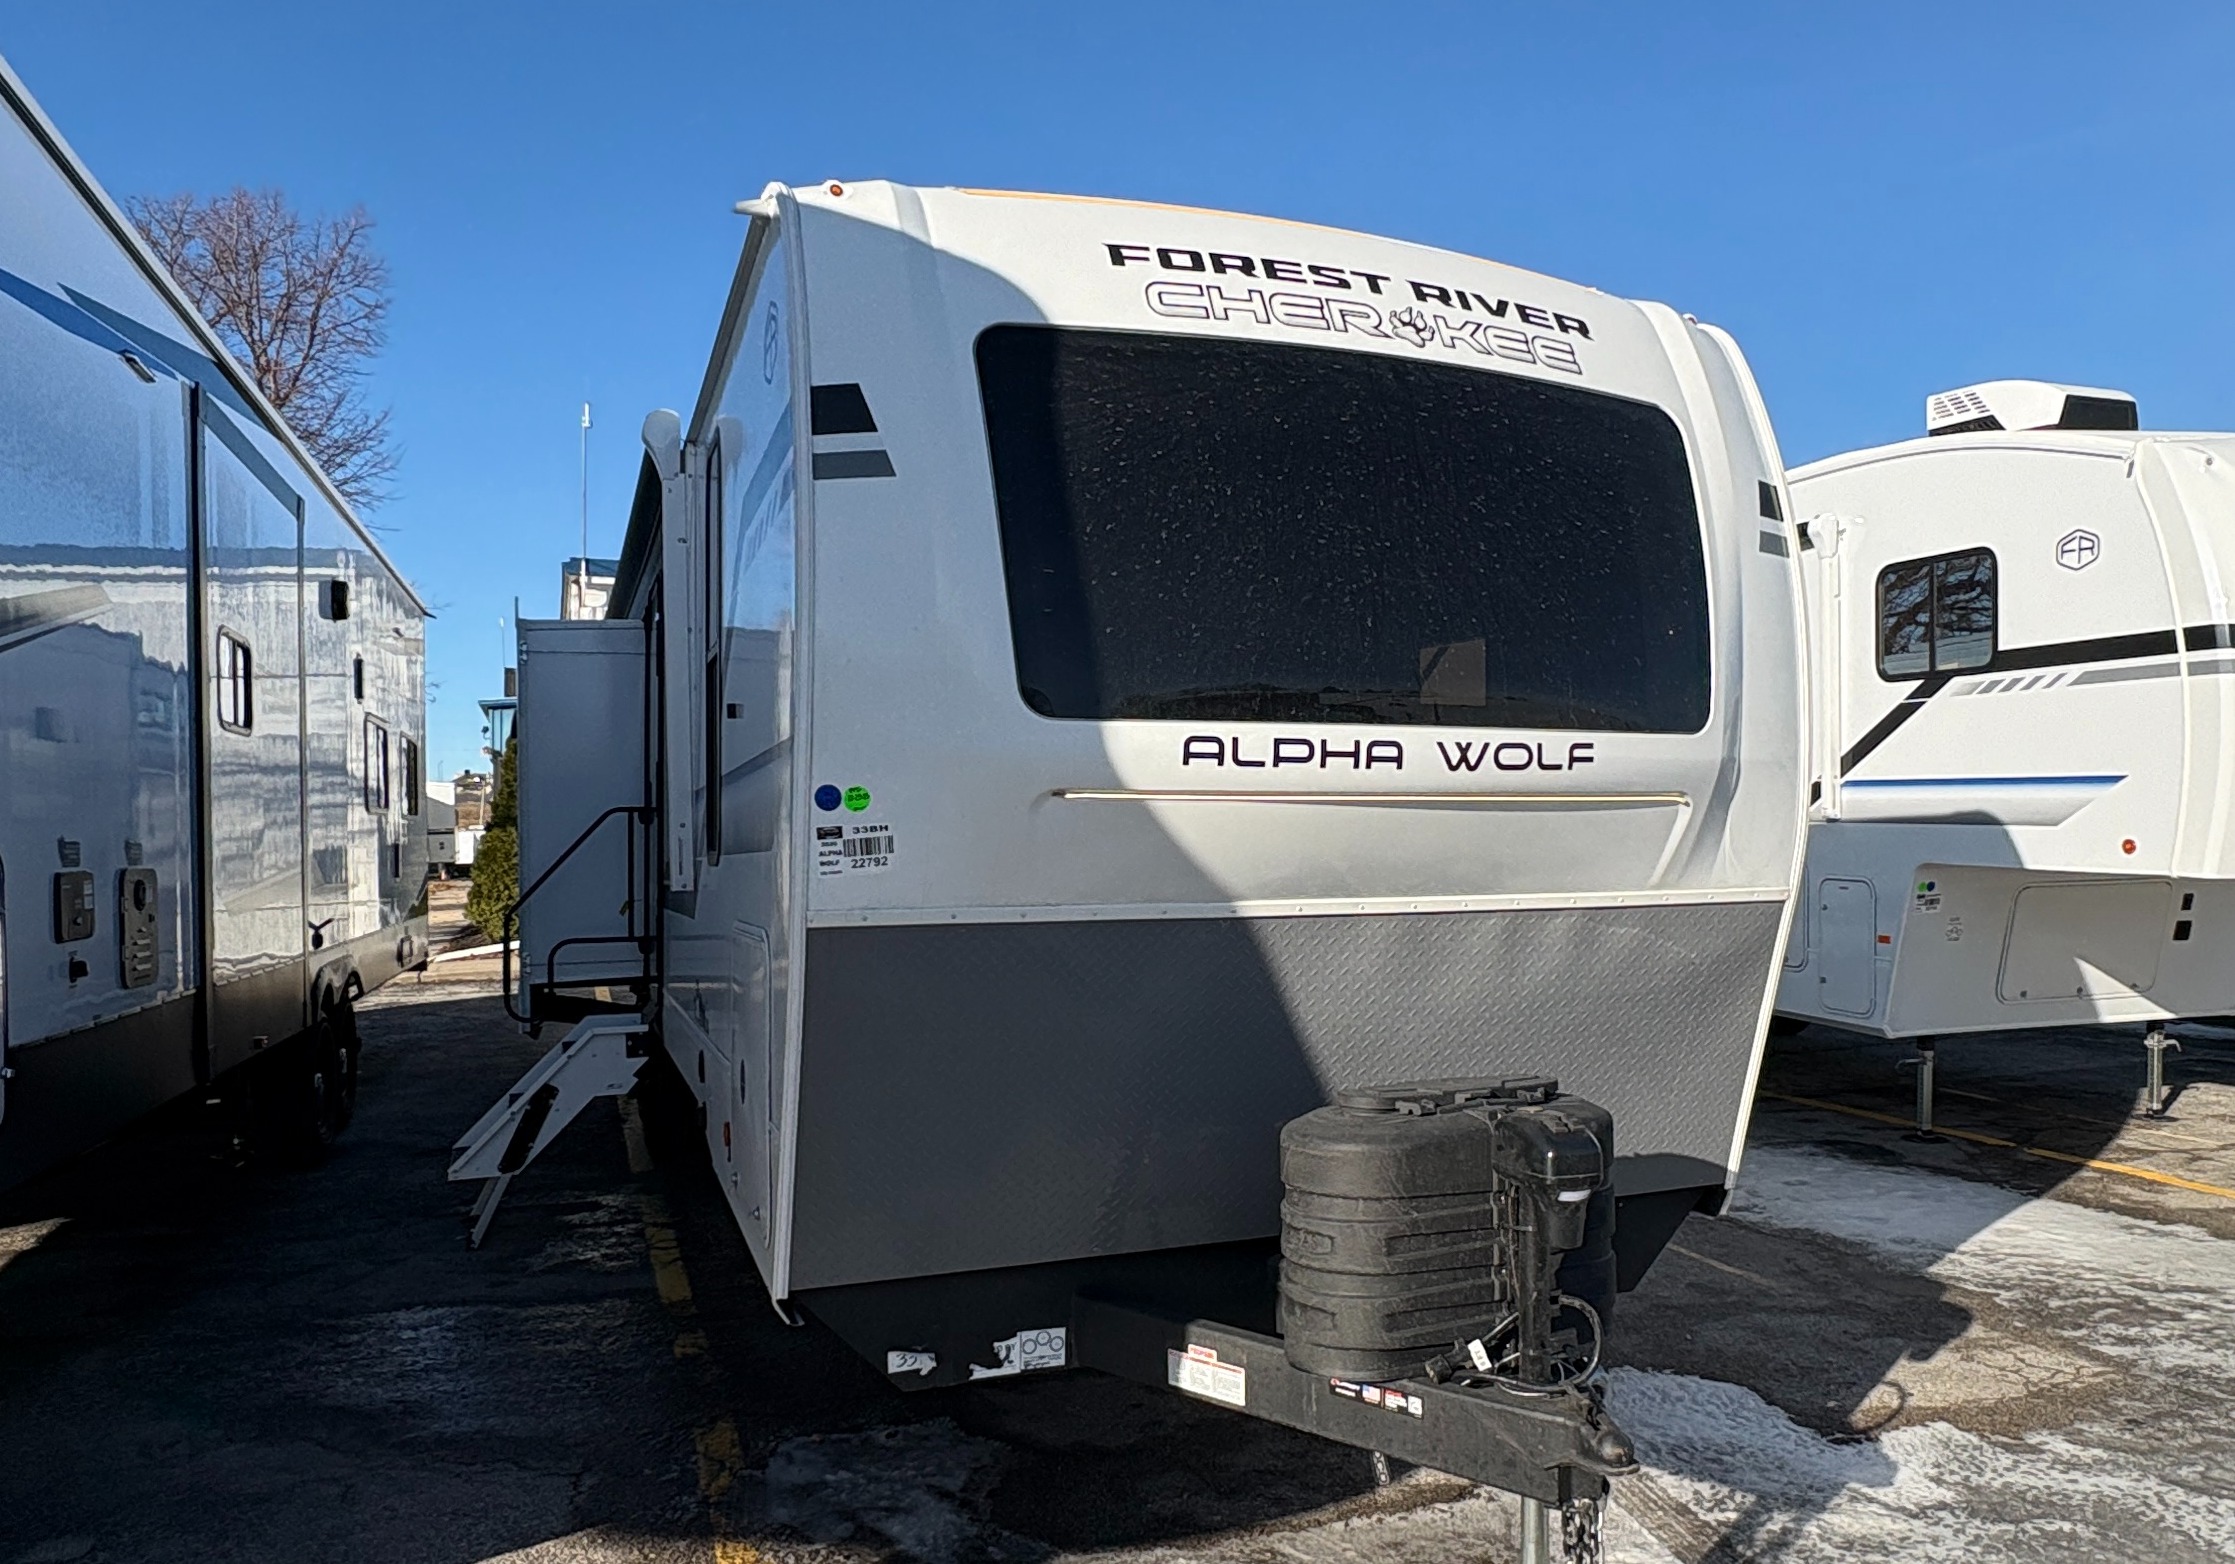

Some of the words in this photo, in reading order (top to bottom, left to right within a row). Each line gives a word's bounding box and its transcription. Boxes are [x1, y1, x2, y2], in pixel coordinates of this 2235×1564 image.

[1102, 243, 1392, 295] FOREST
[1406, 280, 1593, 340] RIVER
[1182, 735, 1404, 769] ALPHA
[1437, 741, 1596, 772] WOLF
[852, 824, 889, 834] 33BH
[851, 856, 889, 868] 22792
